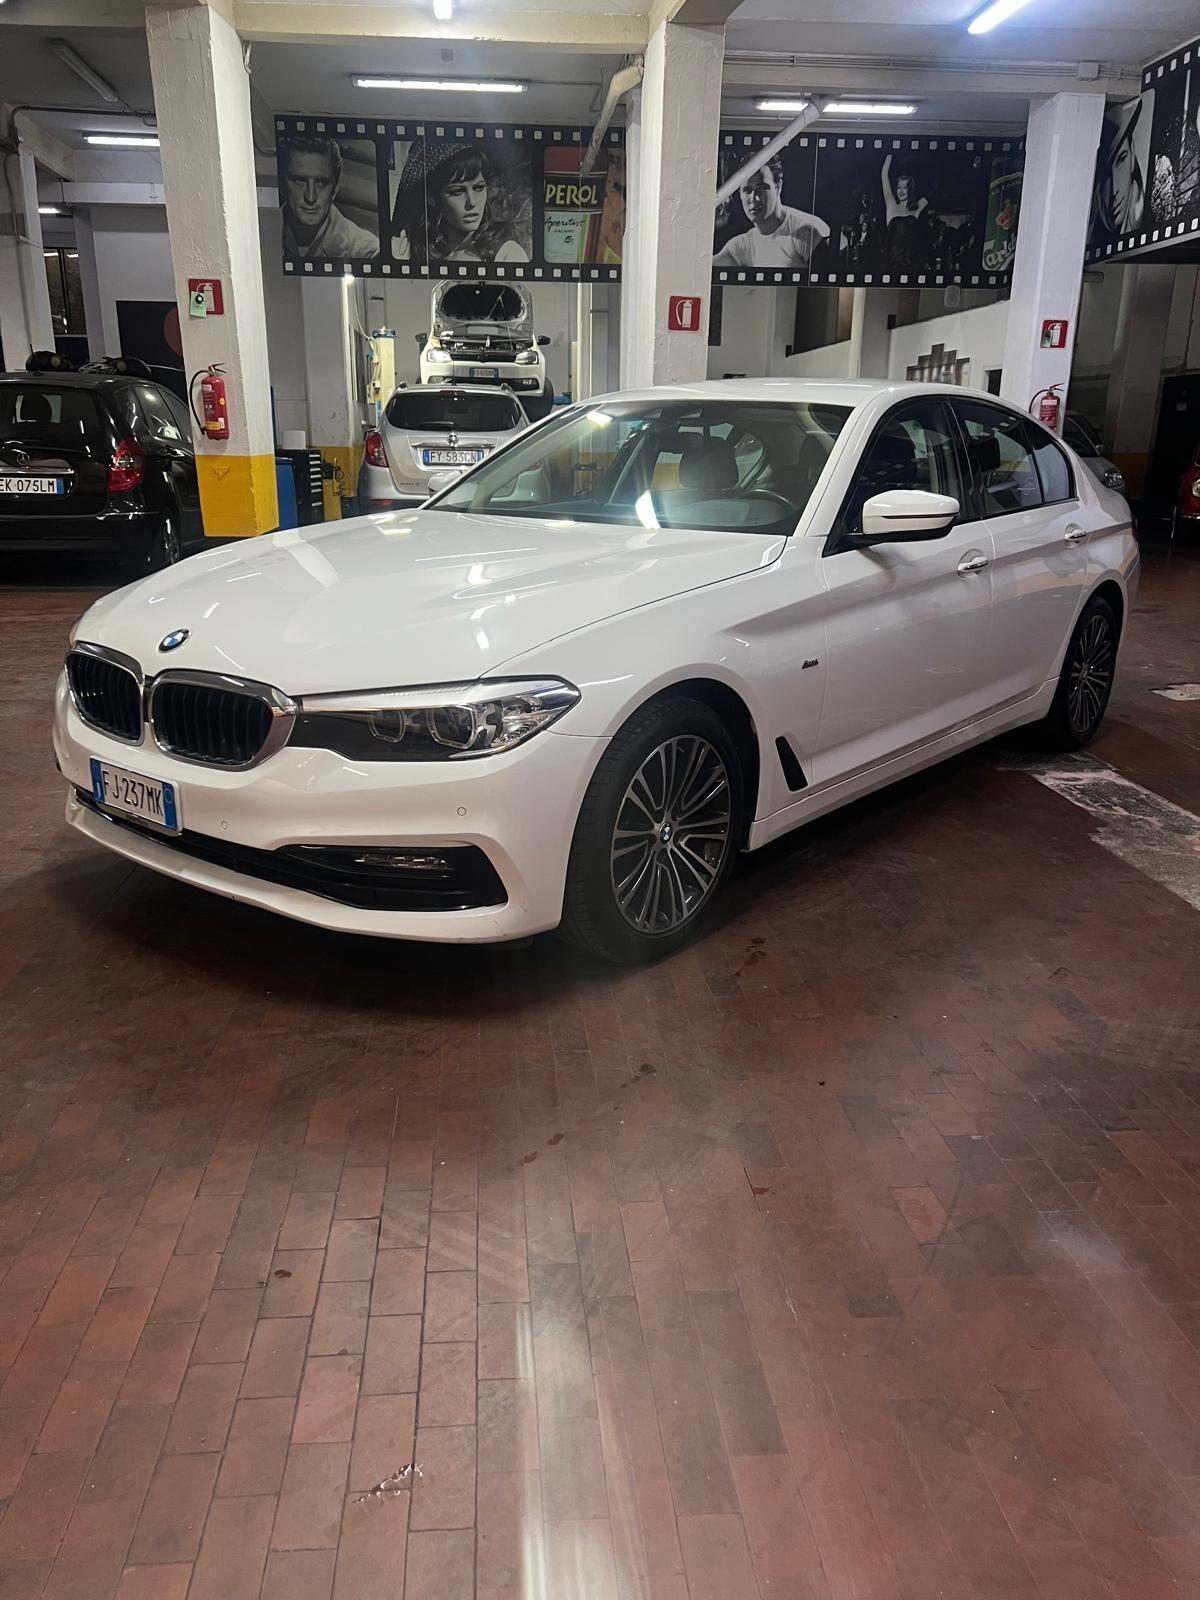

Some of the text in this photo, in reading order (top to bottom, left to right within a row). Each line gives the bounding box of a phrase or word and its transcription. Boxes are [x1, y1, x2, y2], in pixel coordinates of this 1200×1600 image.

[544, 182, 597, 206] PEROL
[17, 479, 55, 493] 075LM
[122, 777, 164, 817] 237MK
